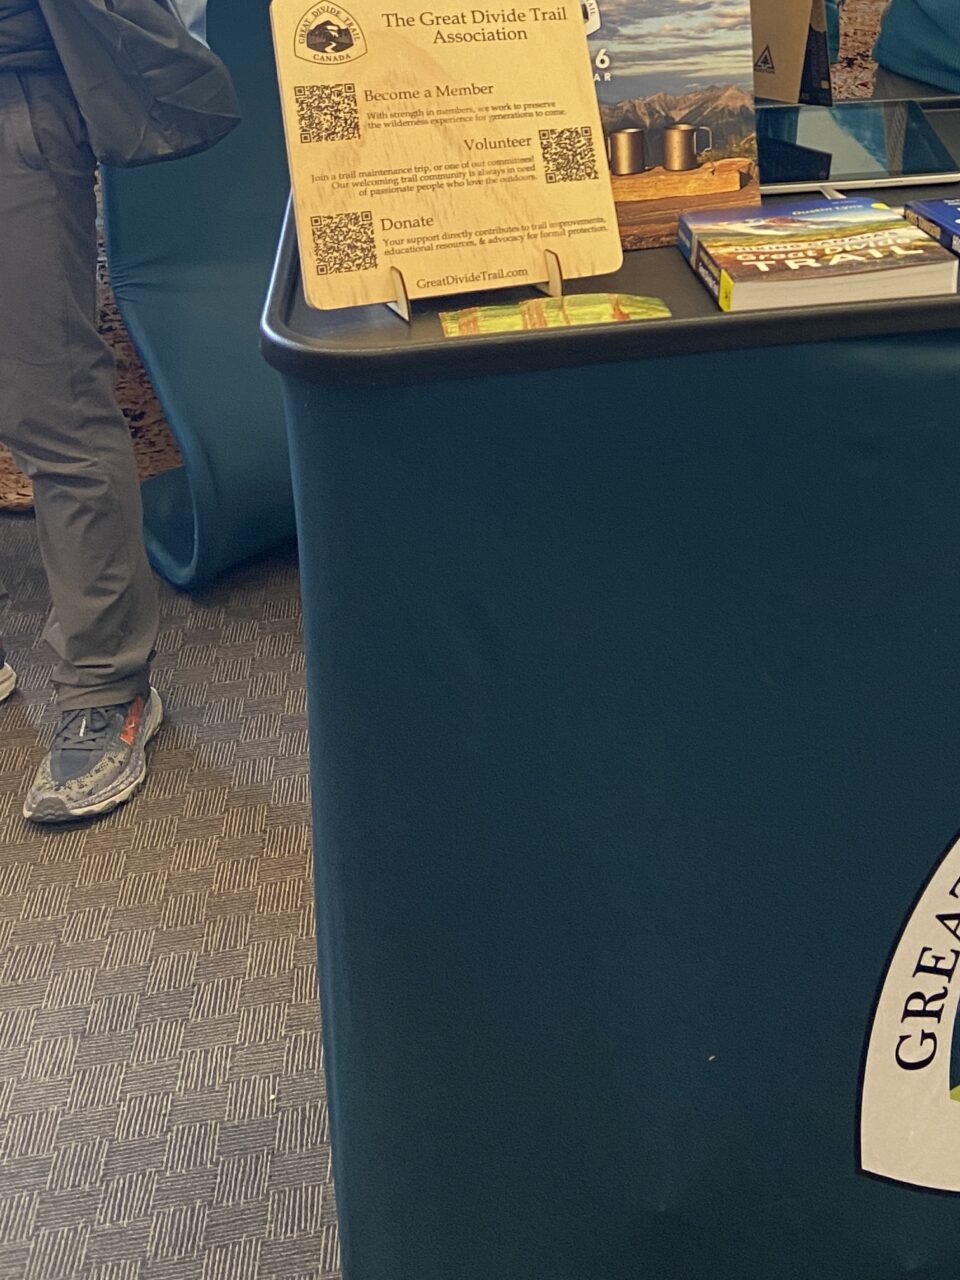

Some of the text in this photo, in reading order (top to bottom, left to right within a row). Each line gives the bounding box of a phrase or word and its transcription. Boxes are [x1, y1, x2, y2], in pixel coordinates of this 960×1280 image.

[298, 6, 360, 44] GREAT DIVIDE TRAIL
[382, 6, 567, 28] The Great Divide Trail
[433, 28, 528, 44] Association
[313, 54, 351, 62] CANADA
[364, 83, 494, 101] Become a Member
[367, 111, 388, 119] With
[389, 109, 424, 120] strength
[435, 106, 474, 116] members,
[490, 104, 512, 112] work
[522, 103, 556, 111] preserve
[368, 120, 381, 128] the
[383, 117, 428, 127] wilderness
[429, 115, 473, 126] experience
[474, 114, 486, 122] for
[488, 111, 534, 122] generations
[534, 110, 543, 118] to
[464, 138, 532, 151] Volunteer
[792, 203, 864, 216] Dustin Lynx
[381, 216, 434, 231] Donate
[382, 236, 404, 247] Your
[406, 233, 440, 246] support
[440, 230, 472, 243] directly
[474, 225, 520, 237] contributes
[520, 224, 529, 232] to
[530, 222, 547, 231] trail
[384, 224, 608, 256] educational resources, & advocacy for formal protection.
[735, 231, 900, 252] HIKING CANADA'S
[736, 238, 911, 261] Great Divide
[743, 247, 924, 272] TRAIL
[417, 269, 528, 289] GreatDivideTrail.com
